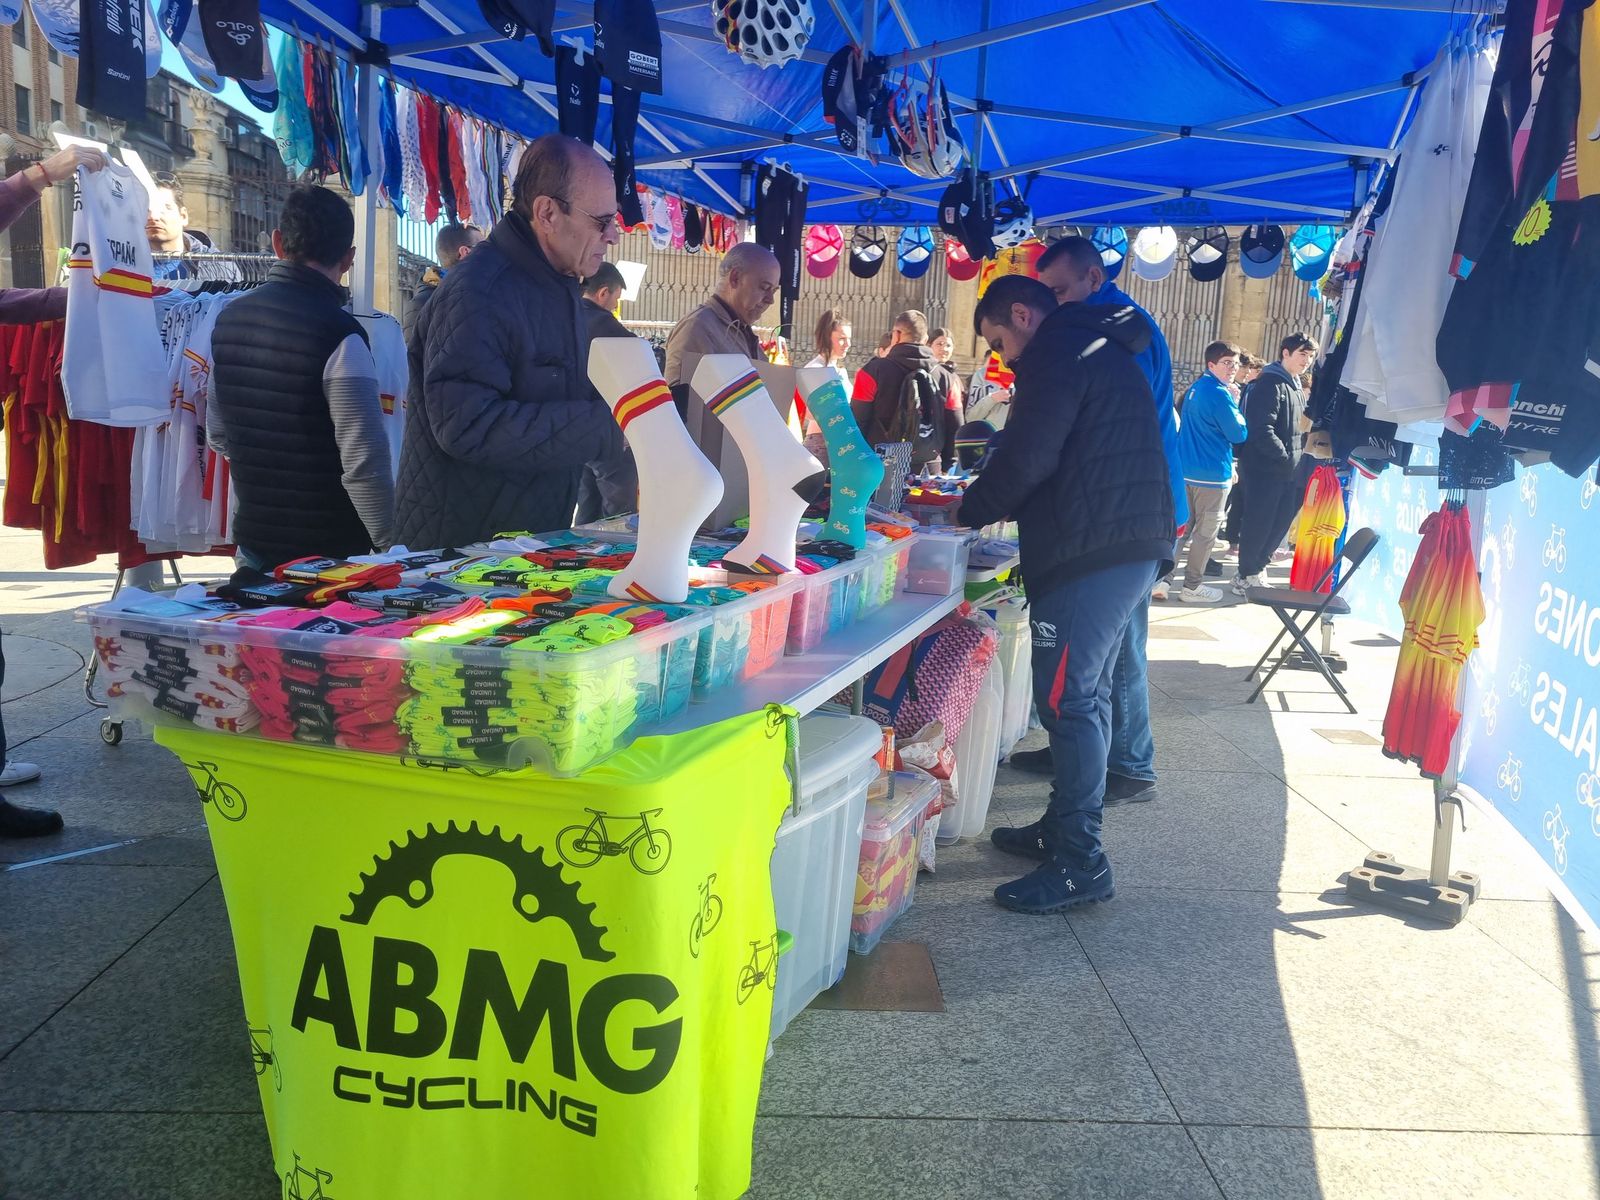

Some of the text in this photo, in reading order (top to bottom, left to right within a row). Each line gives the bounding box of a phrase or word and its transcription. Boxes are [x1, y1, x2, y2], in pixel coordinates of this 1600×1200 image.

[630, 52, 658, 65] GOBERT
[107, 68, 131, 81] Santini
[291, 658, 313, 668] UNIDAD
[290, 685, 312, 696] UNIDAD
[862, 705, 892, 724] LPOZO
[290, 924, 683, 1095] ABMG
[333, 1065, 598, 1138] CYCLING
